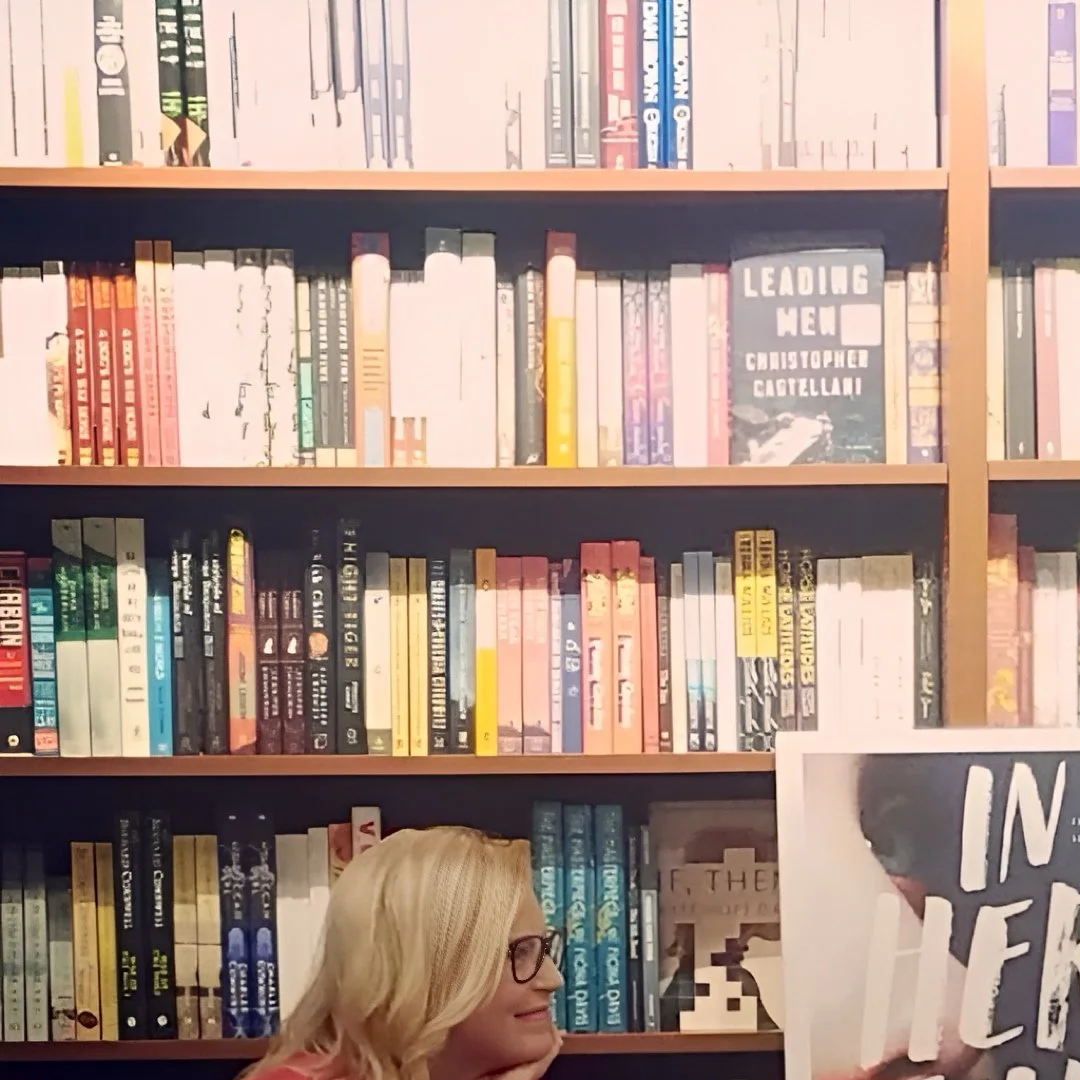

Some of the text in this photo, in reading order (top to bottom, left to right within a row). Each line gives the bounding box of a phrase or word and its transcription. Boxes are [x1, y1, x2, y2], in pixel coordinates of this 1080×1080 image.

[744, 265, 868, 297] LEADING
[777, 306, 836, 337] MEN
[745, 349, 868, 371] CHRISTOPHER
[753, 377, 861, 397] CASTELLANI
[960, 760, 1067, 893] IN
